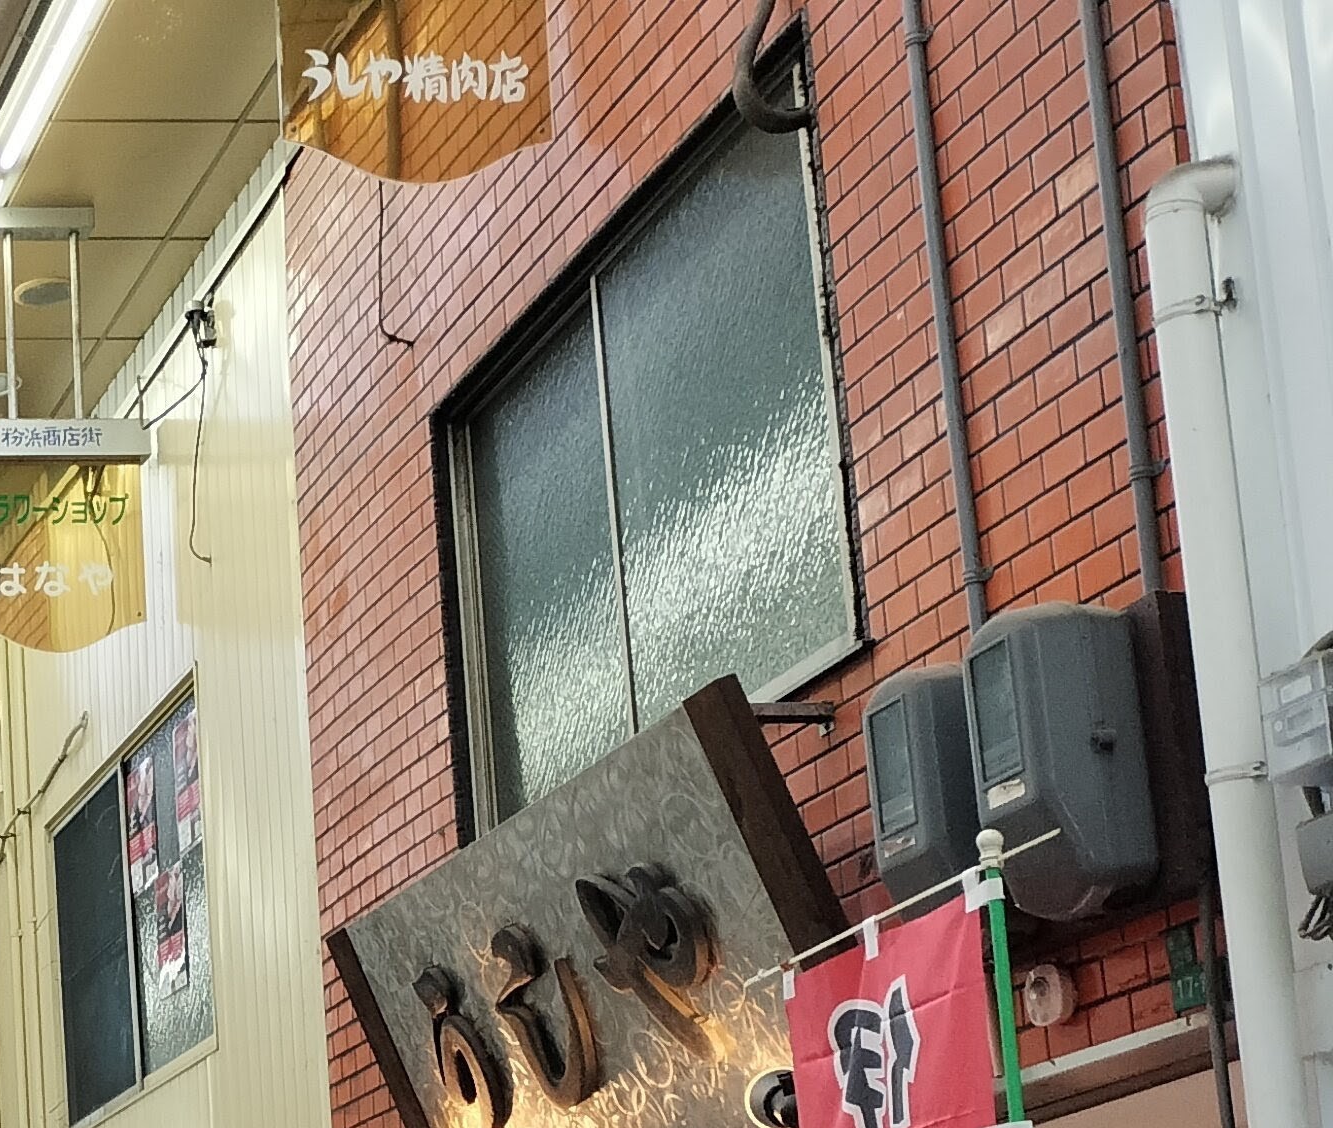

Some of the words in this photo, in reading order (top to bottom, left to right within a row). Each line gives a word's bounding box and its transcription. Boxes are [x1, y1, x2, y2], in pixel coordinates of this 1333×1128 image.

[302, 49, 530, 104] うしや精肉店
[1, 426, 103, 448] 粉浜商店街
